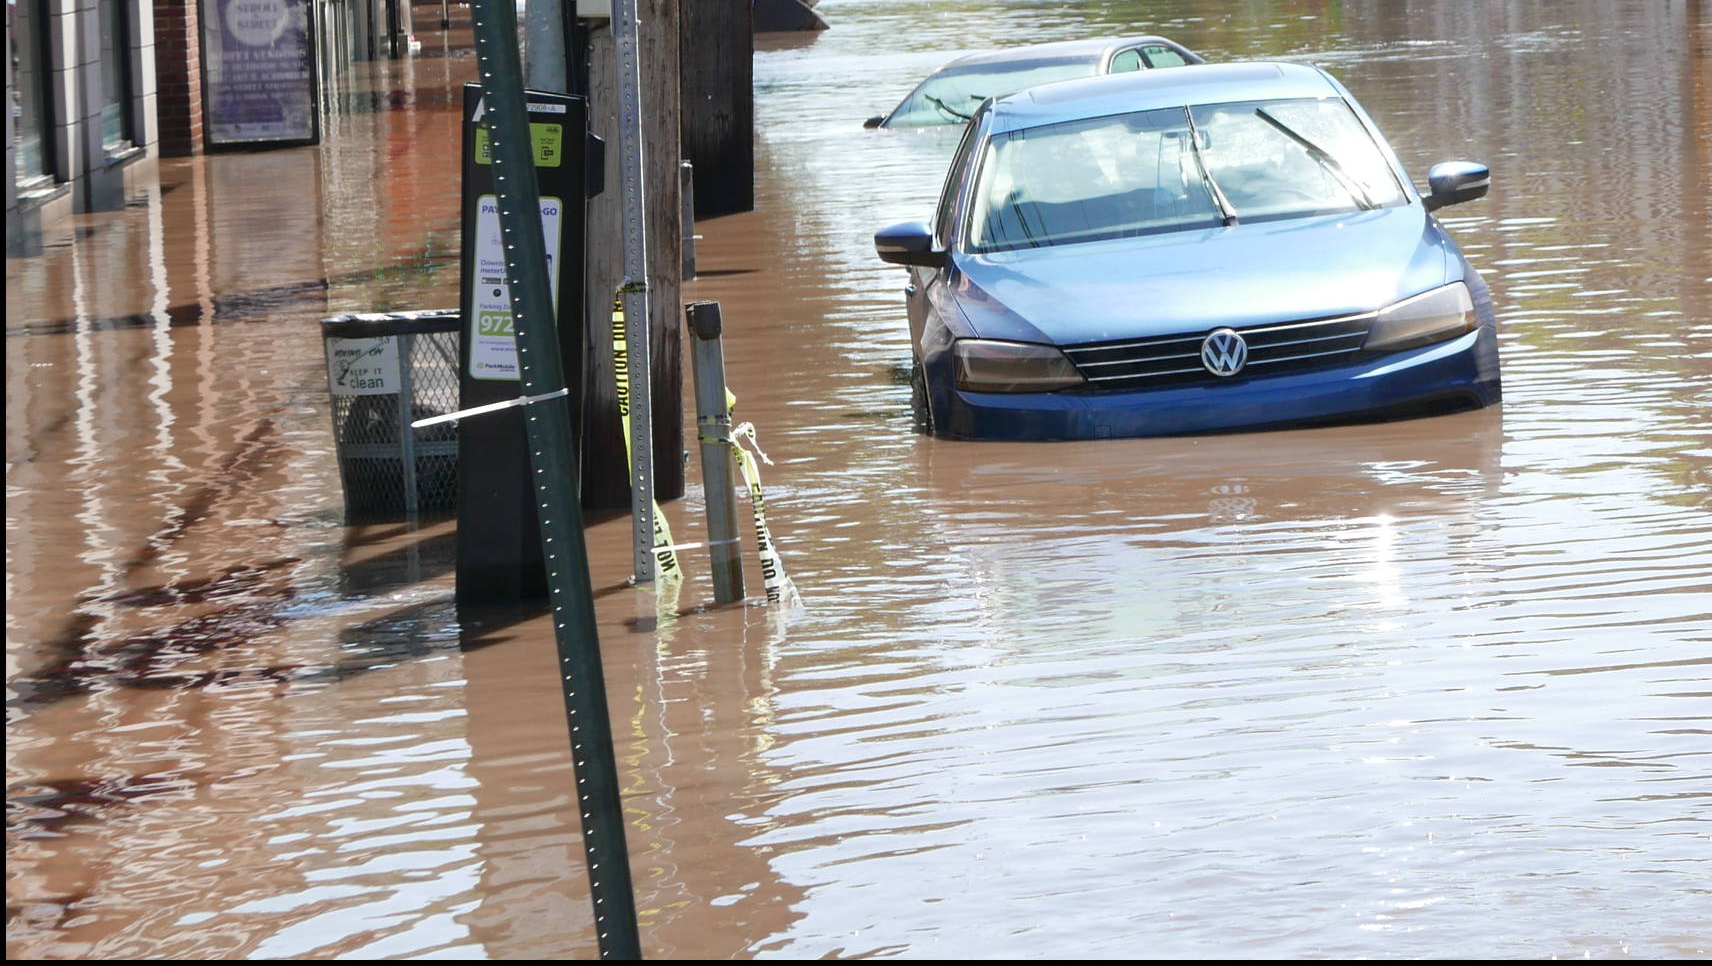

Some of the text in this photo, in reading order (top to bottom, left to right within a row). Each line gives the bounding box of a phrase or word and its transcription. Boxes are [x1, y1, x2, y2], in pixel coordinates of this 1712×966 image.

[479, 314, 515, 333] 972
[1202, 329, 1247, 375] VW
[350, 377, 385, 390] clean
[613, 348, 630, 417] CAUTION
